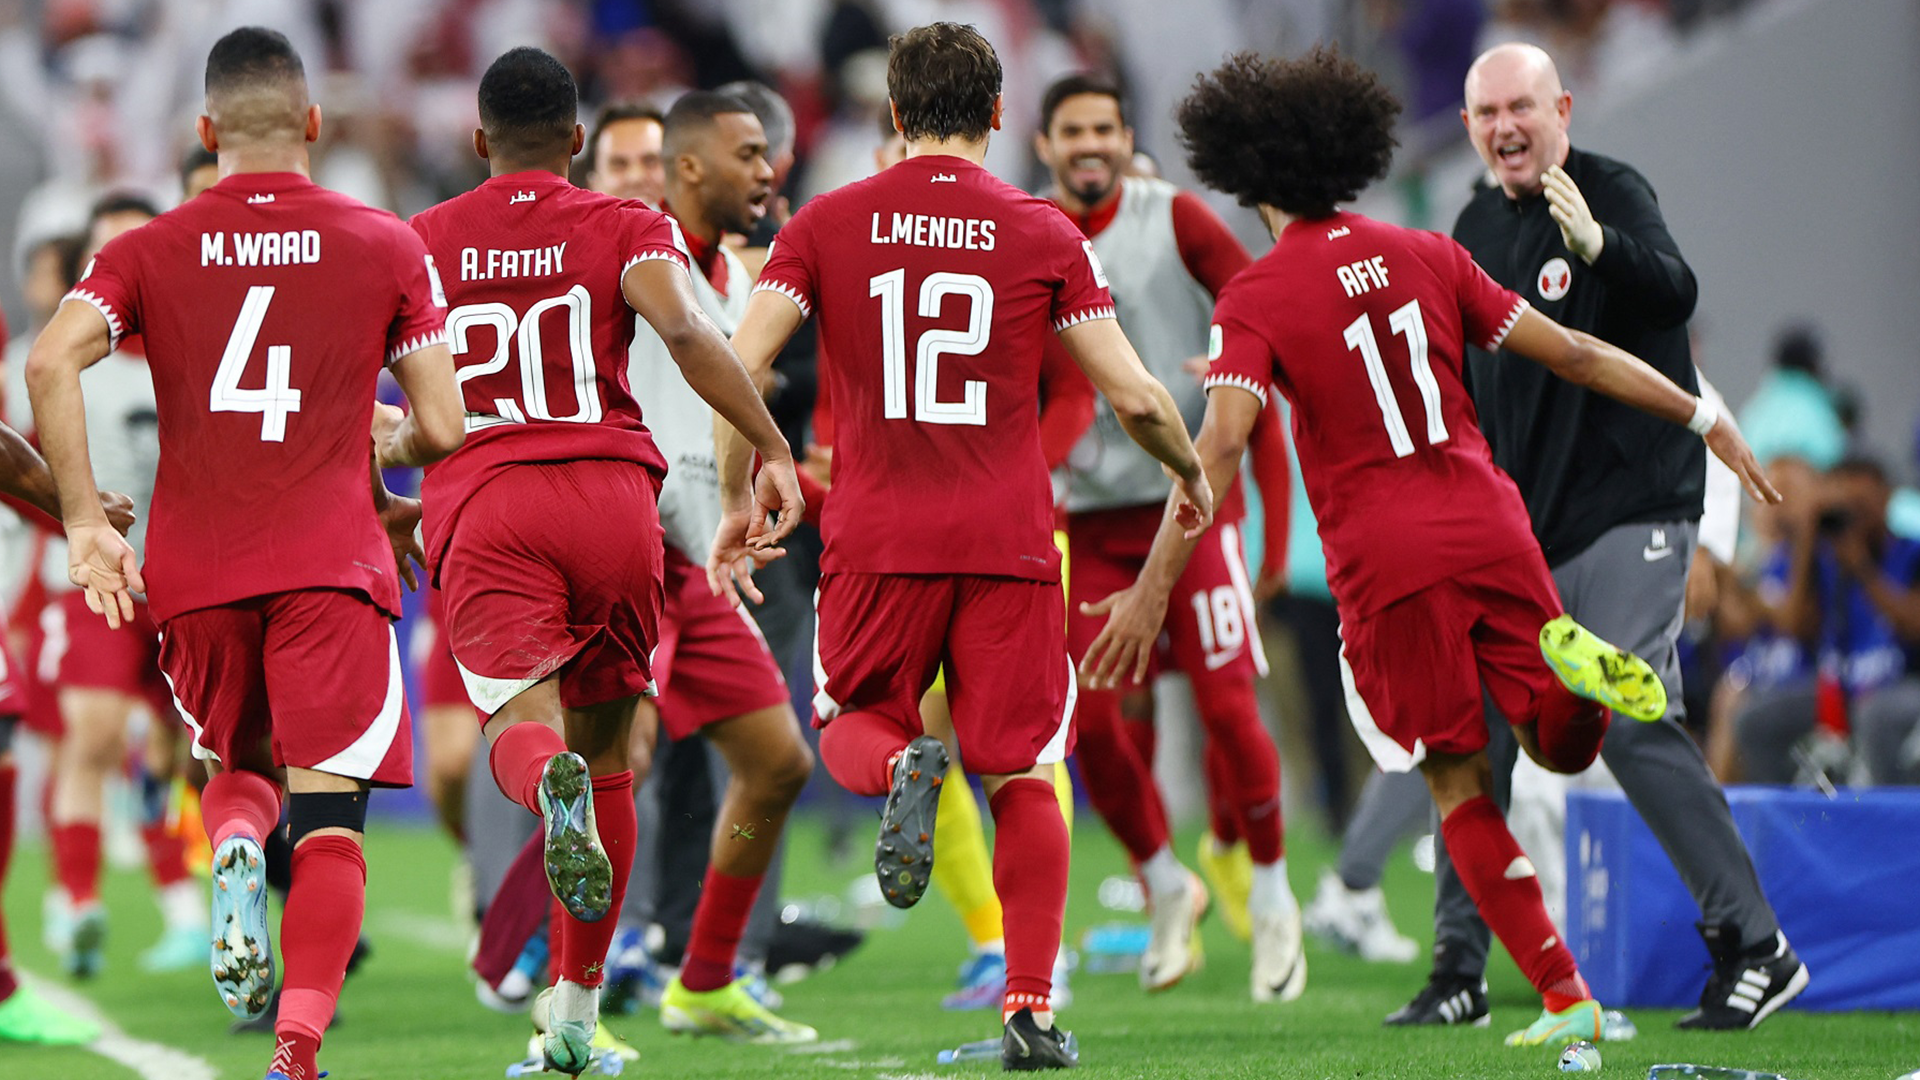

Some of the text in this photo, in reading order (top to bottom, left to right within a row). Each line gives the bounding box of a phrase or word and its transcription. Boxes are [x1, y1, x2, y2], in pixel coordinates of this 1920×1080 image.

[509, 190, 536, 205] قطر
[201, 229, 321, 267] M.WAAD
[870, 211, 997, 251] L.MENDES
[460, 241, 567, 281] A.FATHY
[1336, 254, 1390, 298] AFIF
[210, 285, 301, 442] 4
[445, 284, 603, 434] 20
[869, 268, 994, 426] 12
[1342, 298, 1450, 458] 11
[1190, 584, 1245, 653] 18
